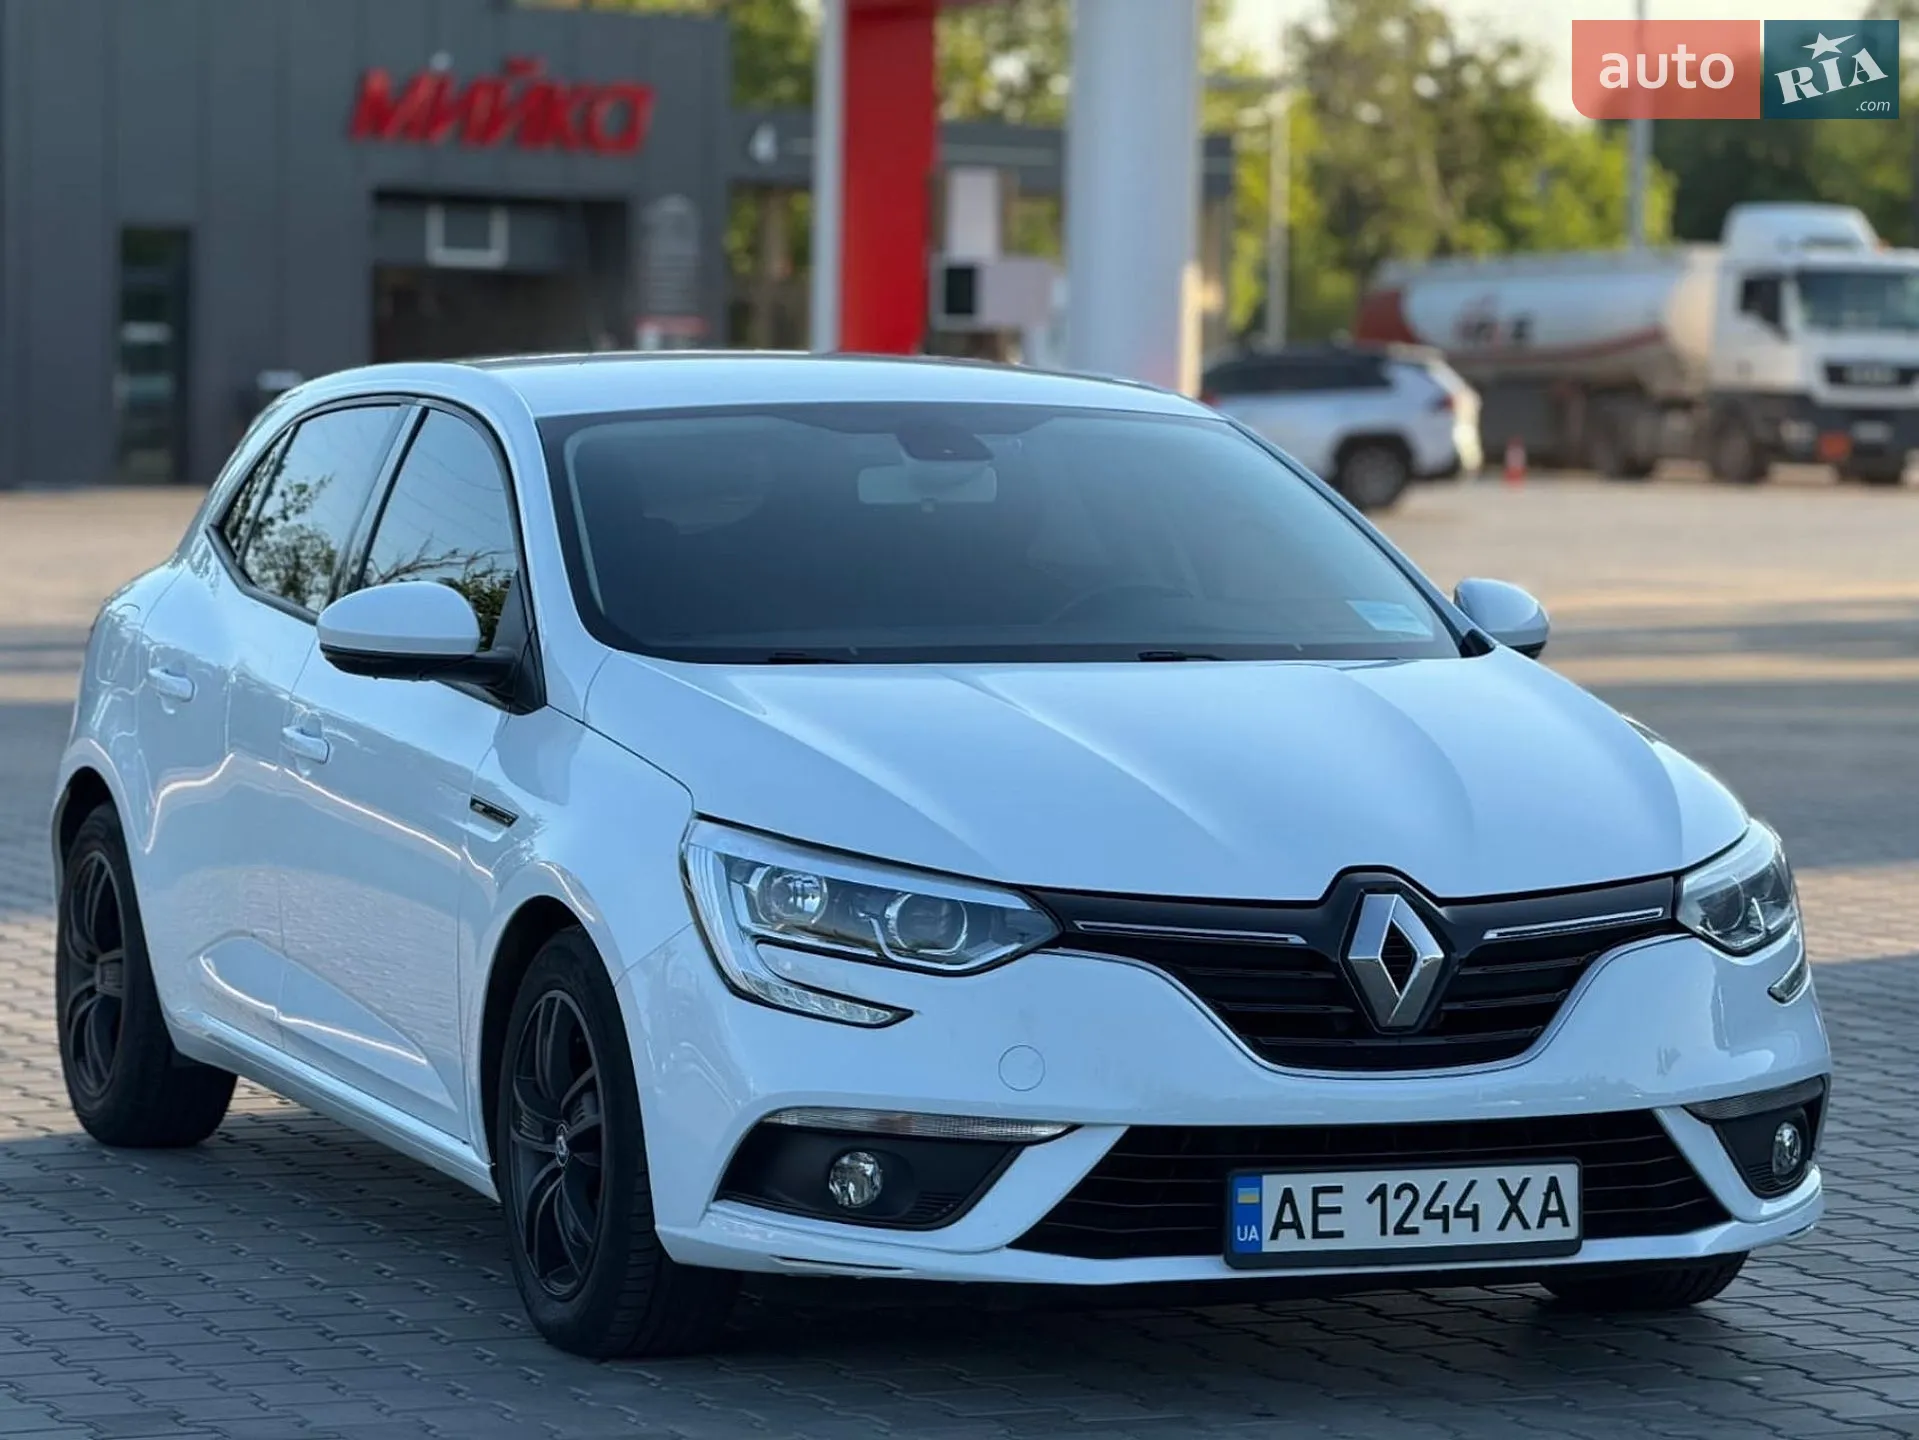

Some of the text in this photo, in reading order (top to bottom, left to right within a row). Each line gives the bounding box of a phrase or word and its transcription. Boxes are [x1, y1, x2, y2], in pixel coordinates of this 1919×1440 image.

[1269, 1175, 1571, 1241] AE 1244 XA
[1236, 1224, 1260, 1242] UA
